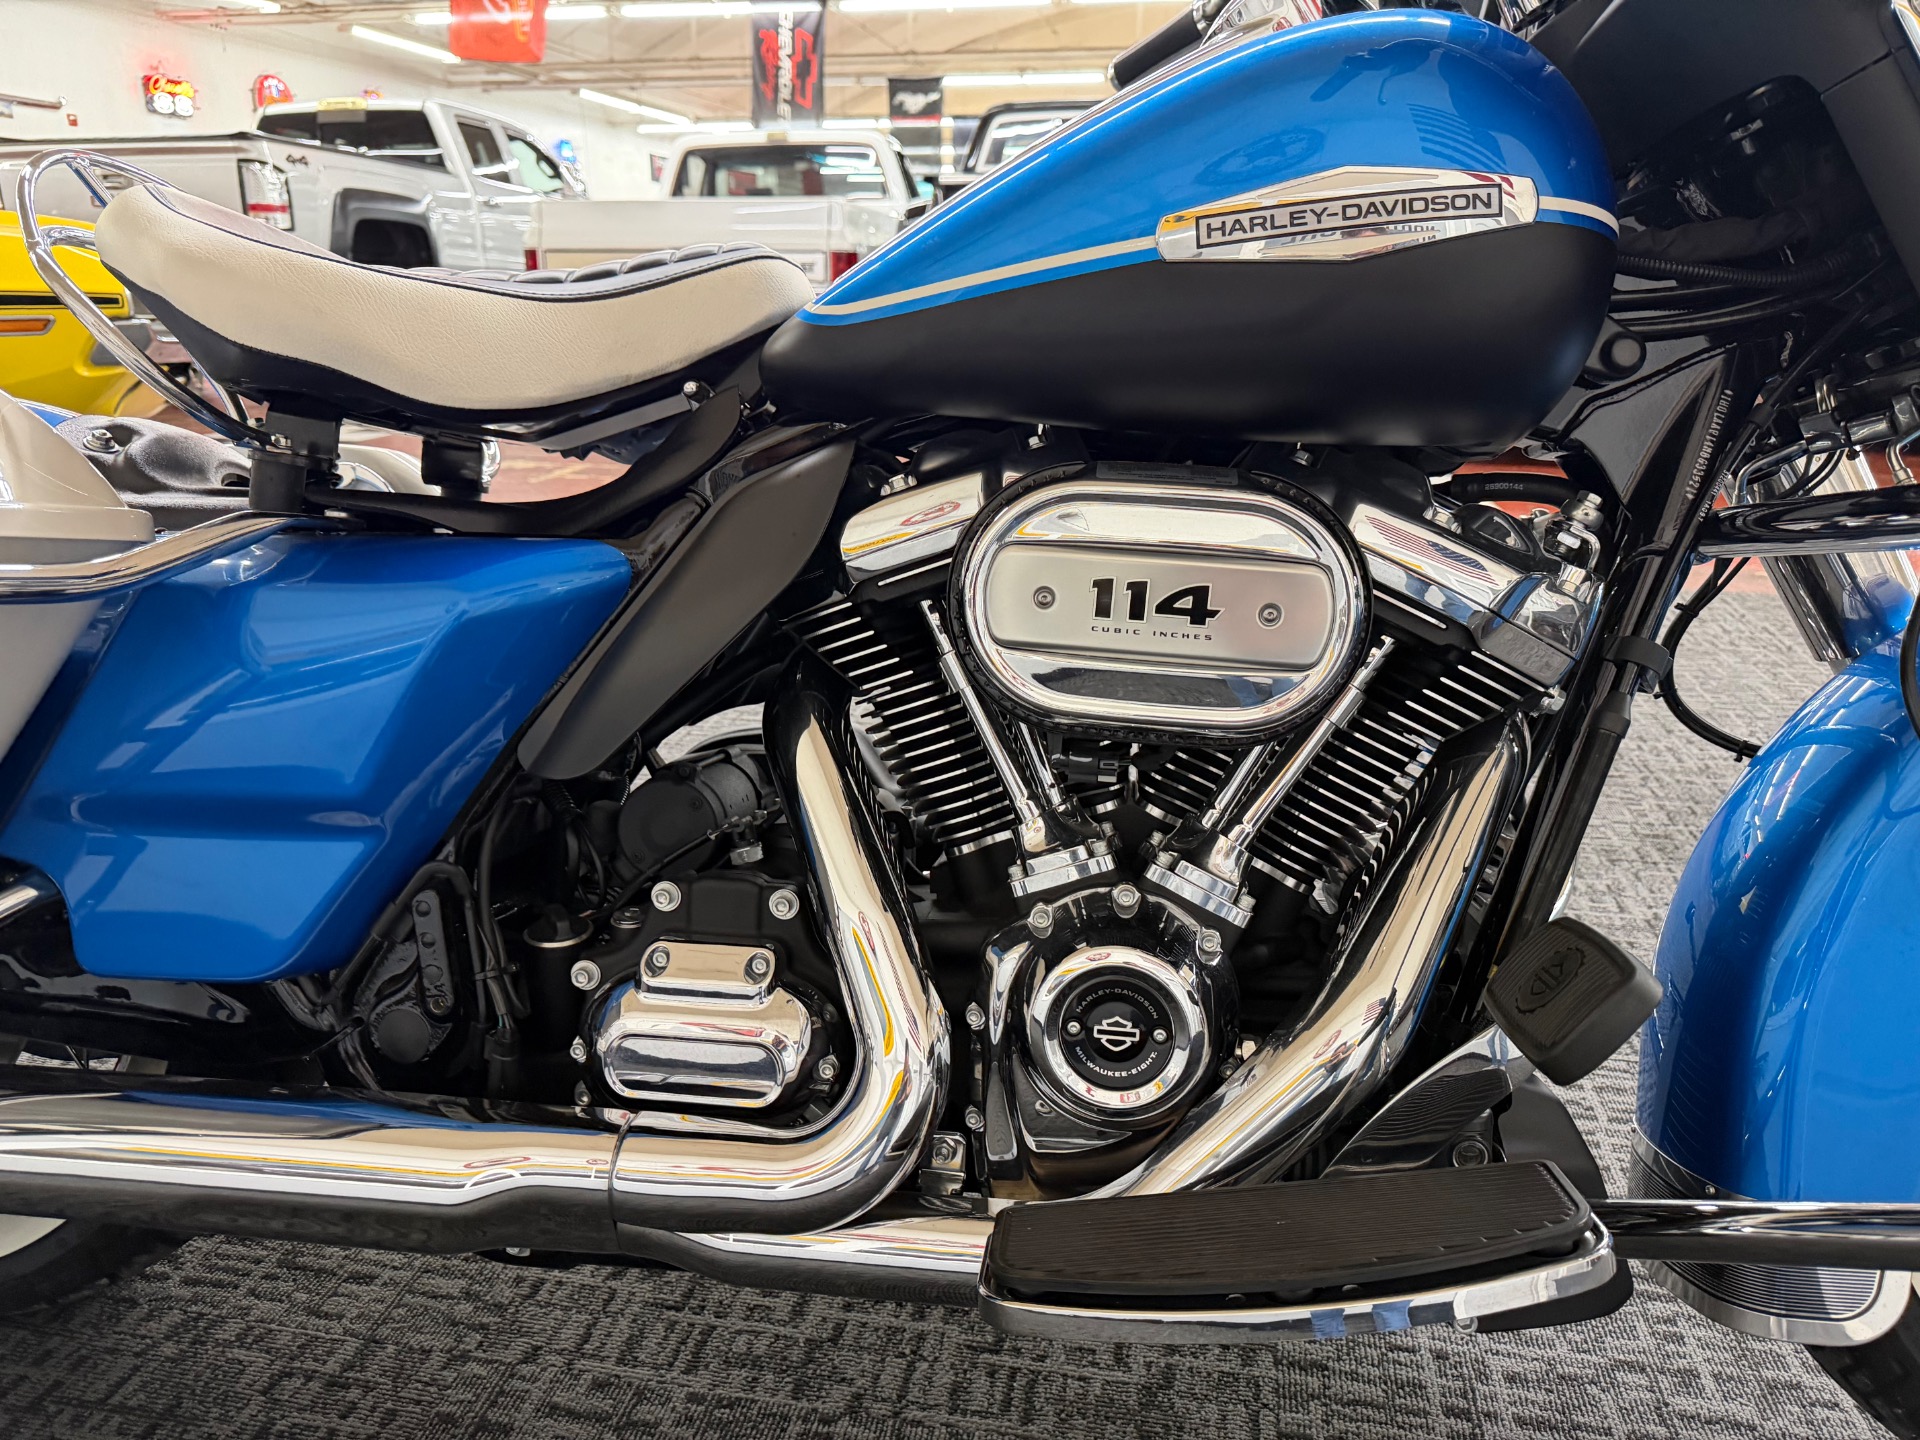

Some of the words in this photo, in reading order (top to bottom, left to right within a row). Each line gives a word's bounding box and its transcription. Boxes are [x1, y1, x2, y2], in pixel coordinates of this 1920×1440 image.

[1206, 192, 1493, 239] HARLEY-DAVIDSON
[1089, 576, 1225, 628] 114
[1091, 625, 1141, 635] CUBIC
[1152, 630, 1213, 641] INCHES
[1076, 988, 1158, 1019] HARLEY-DAVIDSON
